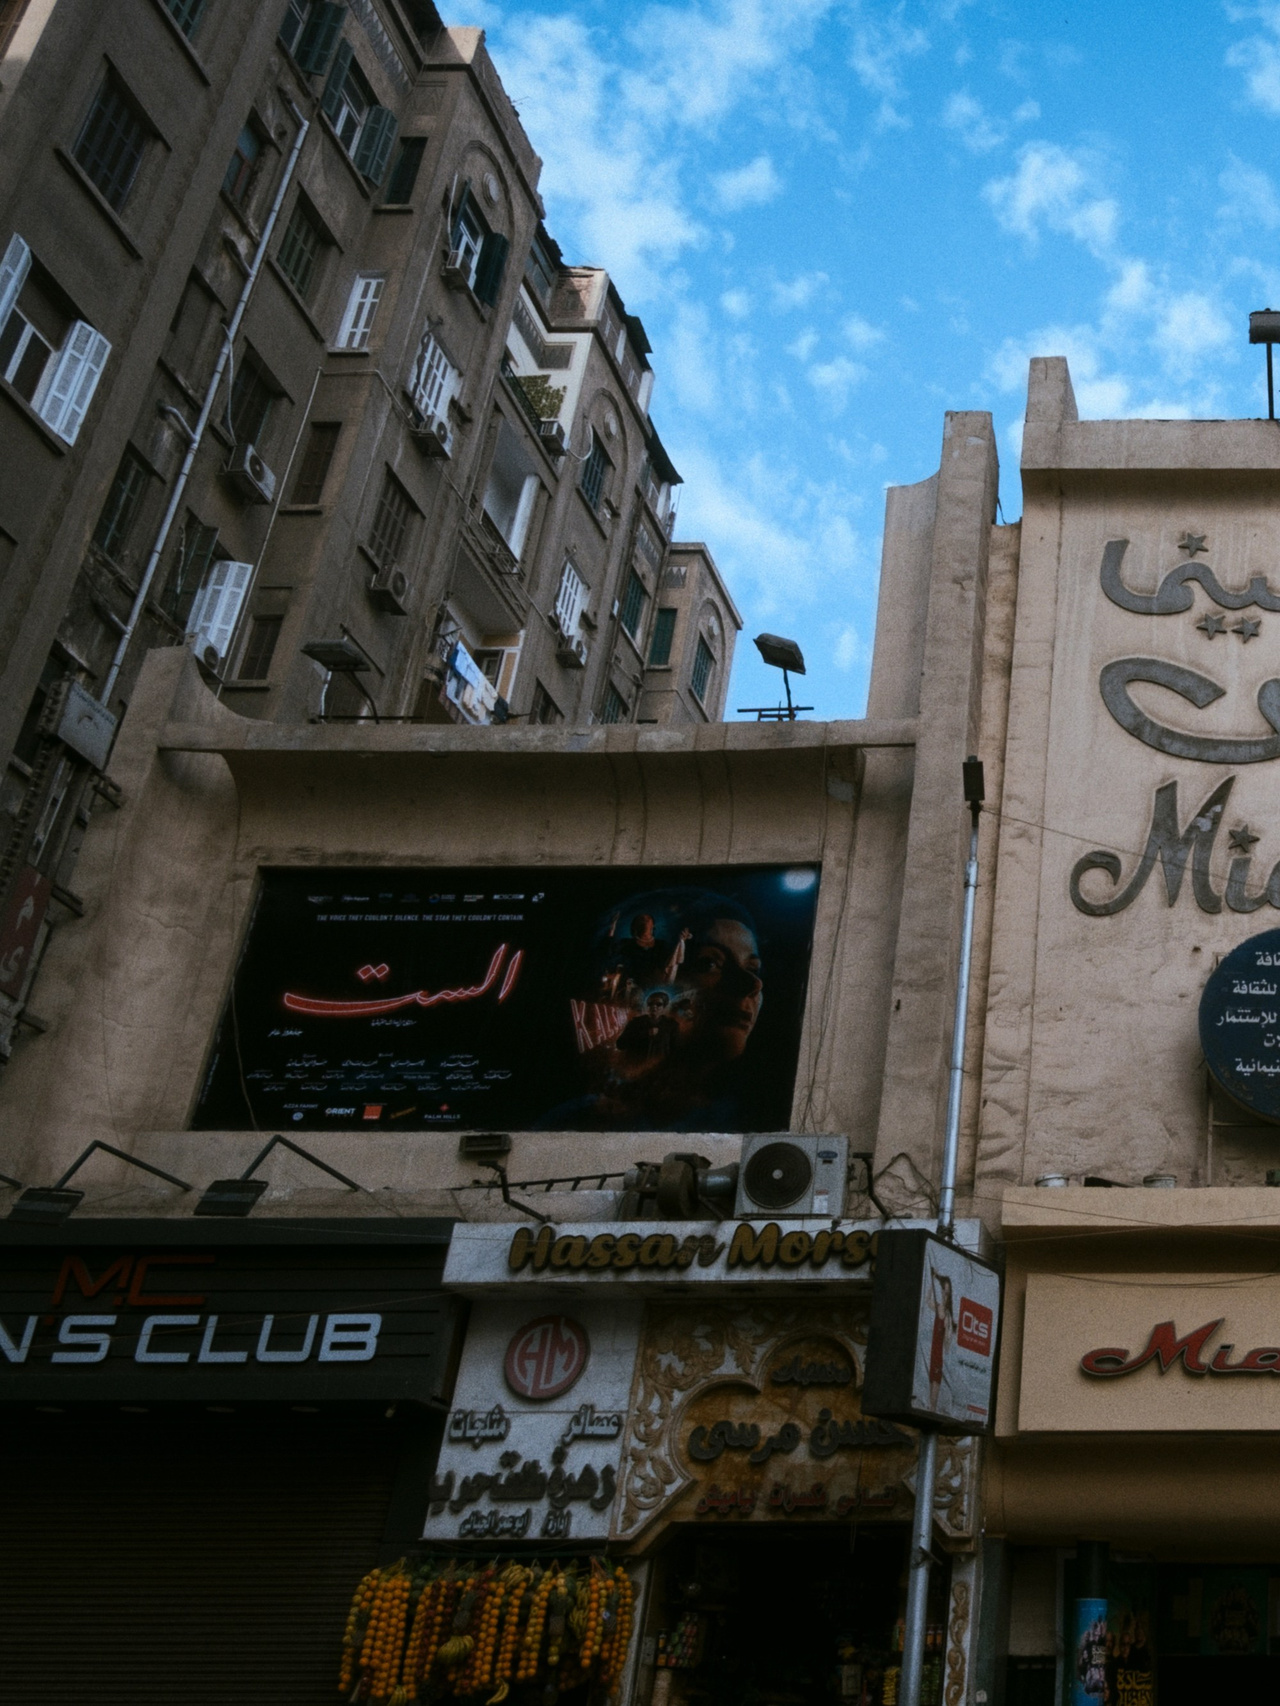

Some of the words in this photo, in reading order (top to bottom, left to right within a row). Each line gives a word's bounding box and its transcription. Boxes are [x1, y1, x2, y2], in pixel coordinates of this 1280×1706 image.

[317, 914, 328, 922] THE
[422, 914, 433, 922] THE
[281, 942, 525, 1017] الست
[1232, 980, 1278, 996] للثقافة
[508, 1224, 726, 1271] Hassan
[134, 1313, 383, 1364] CLUB
[449, 1404, 510, 1449] مثلجات
[562, 1404, 624, 1446] عصائر
[809, 1408, 915, 1457] حسن
